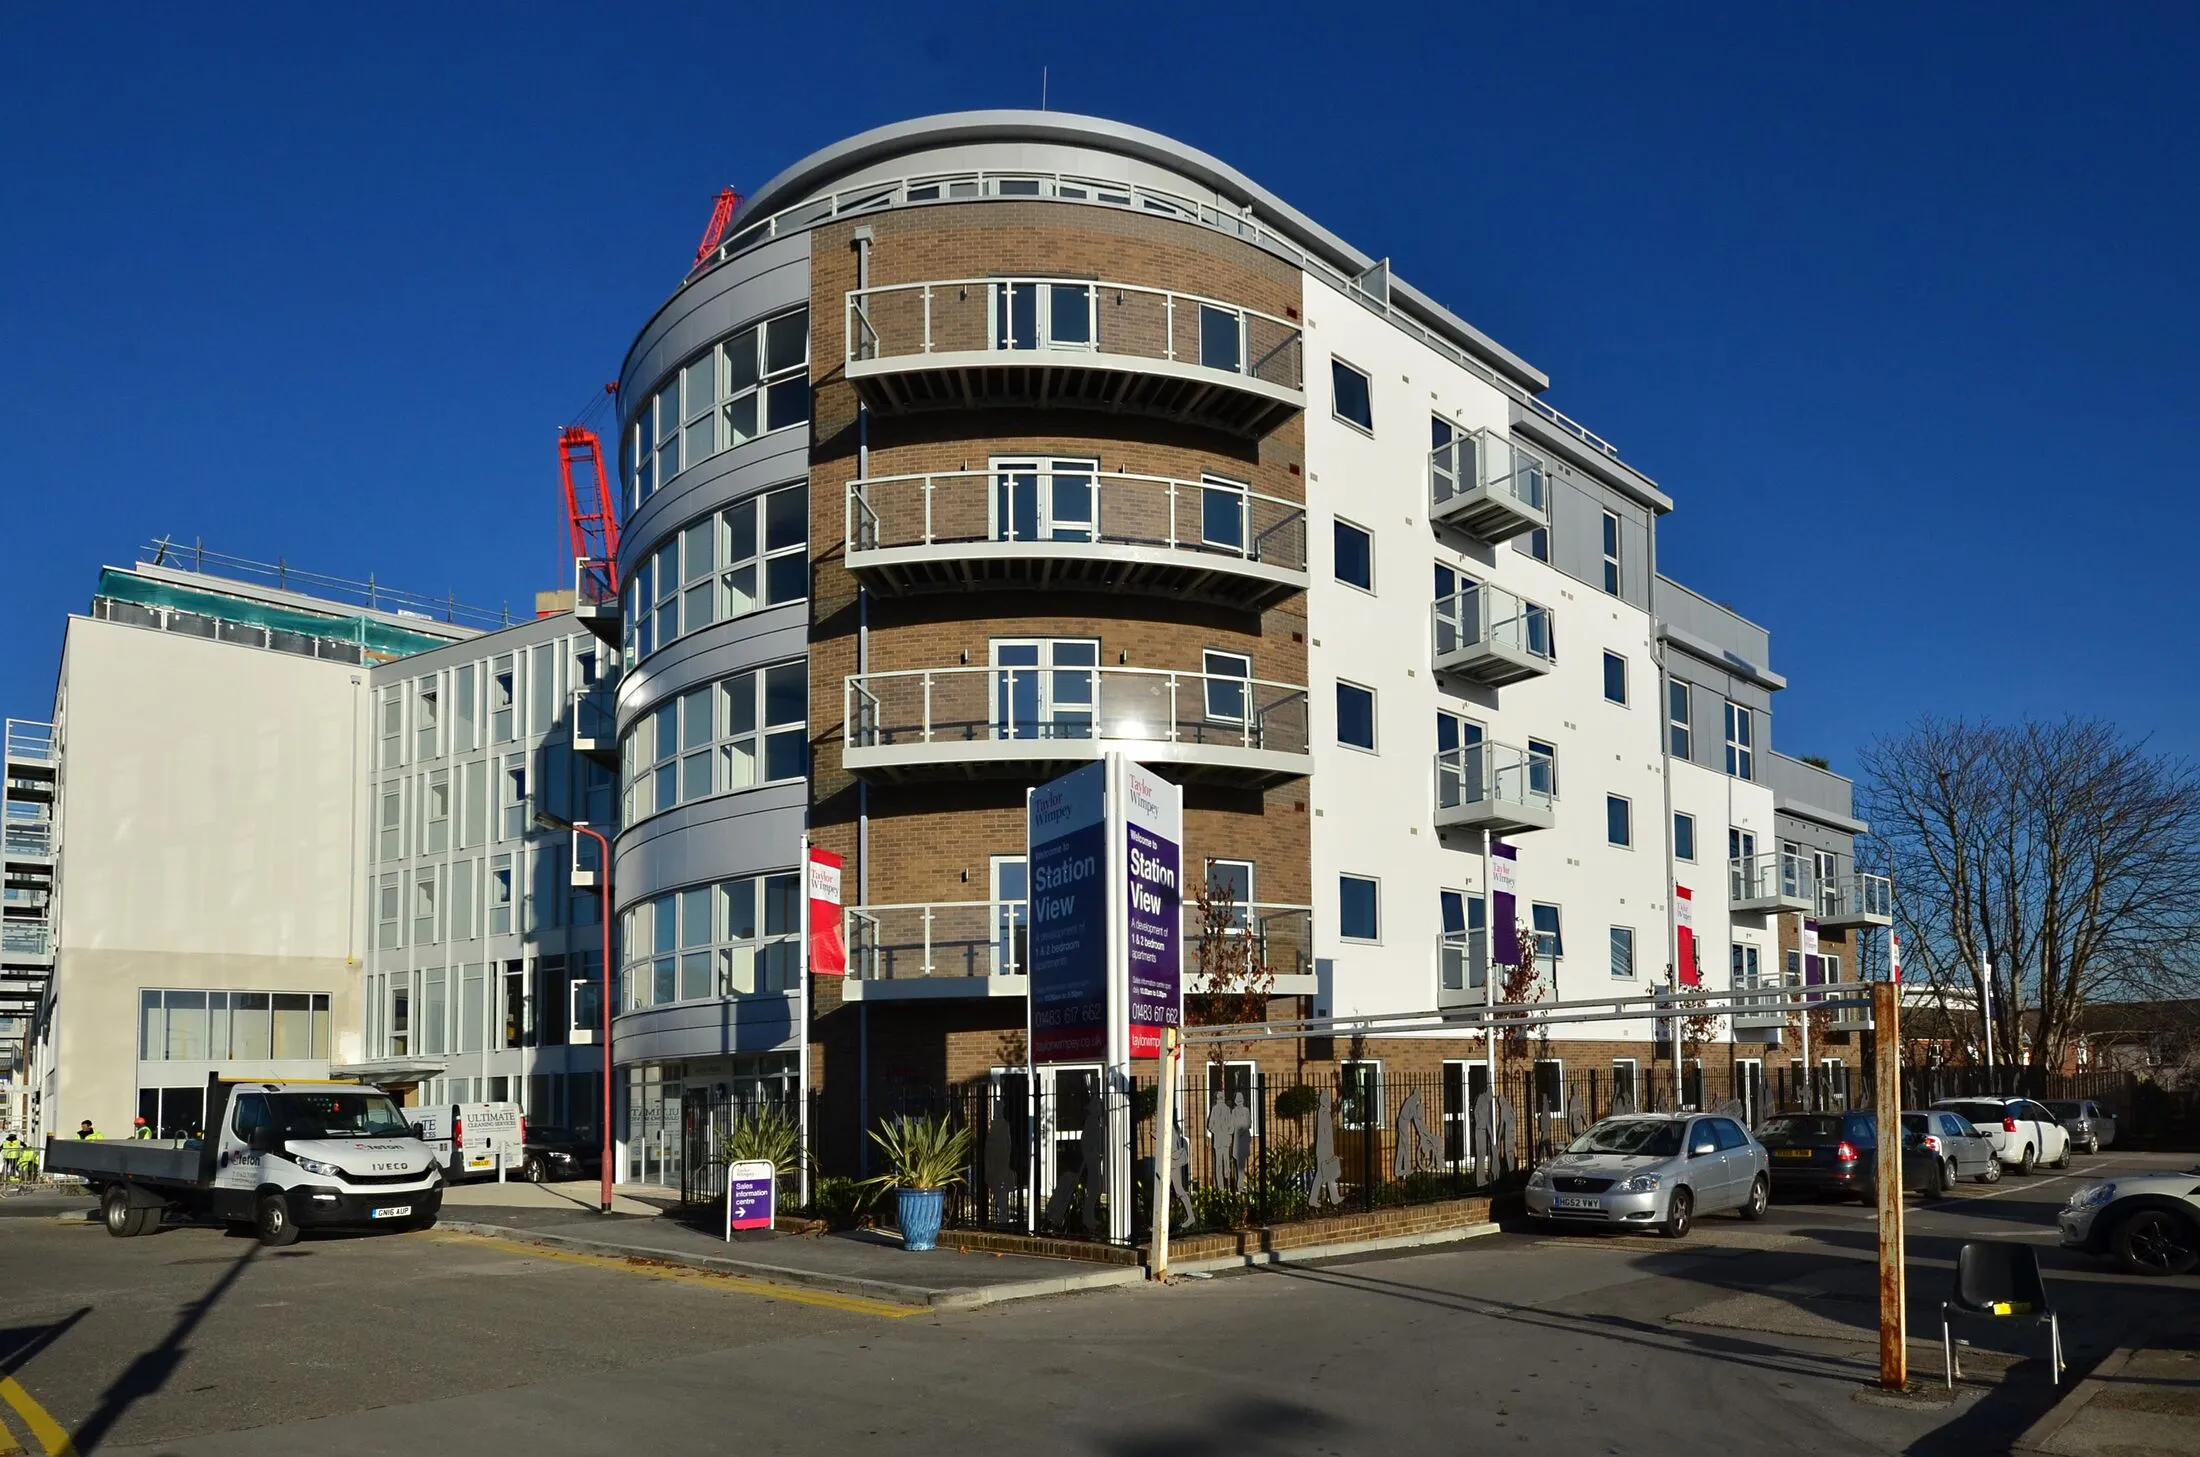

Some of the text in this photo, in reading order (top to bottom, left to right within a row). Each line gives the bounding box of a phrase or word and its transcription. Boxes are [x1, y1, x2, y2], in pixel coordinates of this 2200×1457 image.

[1130, 774, 1152, 798] Taylor
[1035, 791, 1063, 813] Taylor
[1130, 789, 1159, 819] Wimpey
[1035, 804, 1072, 827] Wimpey
[1130, 829, 1151, 848] Welcome
[810, 869, 833, 883] Taylor
[1035, 856, 1095, 892] Station
[1130, 847, 1174, 888] Station
[811, 879, 838, 897] Wimpey
[1130, 880, 1161, 915] View
[1035, 895, 1075, 923] View
[1131, 918, 1136, 928] A
[1136, 921, 1164, 937] development
[1051, 940, 1080, 953] bedroom
[1145, 937, 1165, 951] bedroom
[1131, 950, 1157, 963] apartments
[1035, 1002, 1102, 1028] 01483 617 662
[1132, 1002, 1178, 1024] 01483 617 662
[1132, 1033, 1160, 1048] taylorwimp
[467, 1112, 516, 1122] ULTIMATE
[372, 1162, 408, 1171] IVECO
[735, 1189, 768, 1197] information
[736, 1182, 753, 1190] Sales
[735, 1198, 755, 1206] centre
[1560, 1198, 1580, 1207] HG52
[378, 1207, 409, 1217] GN16 AUP
